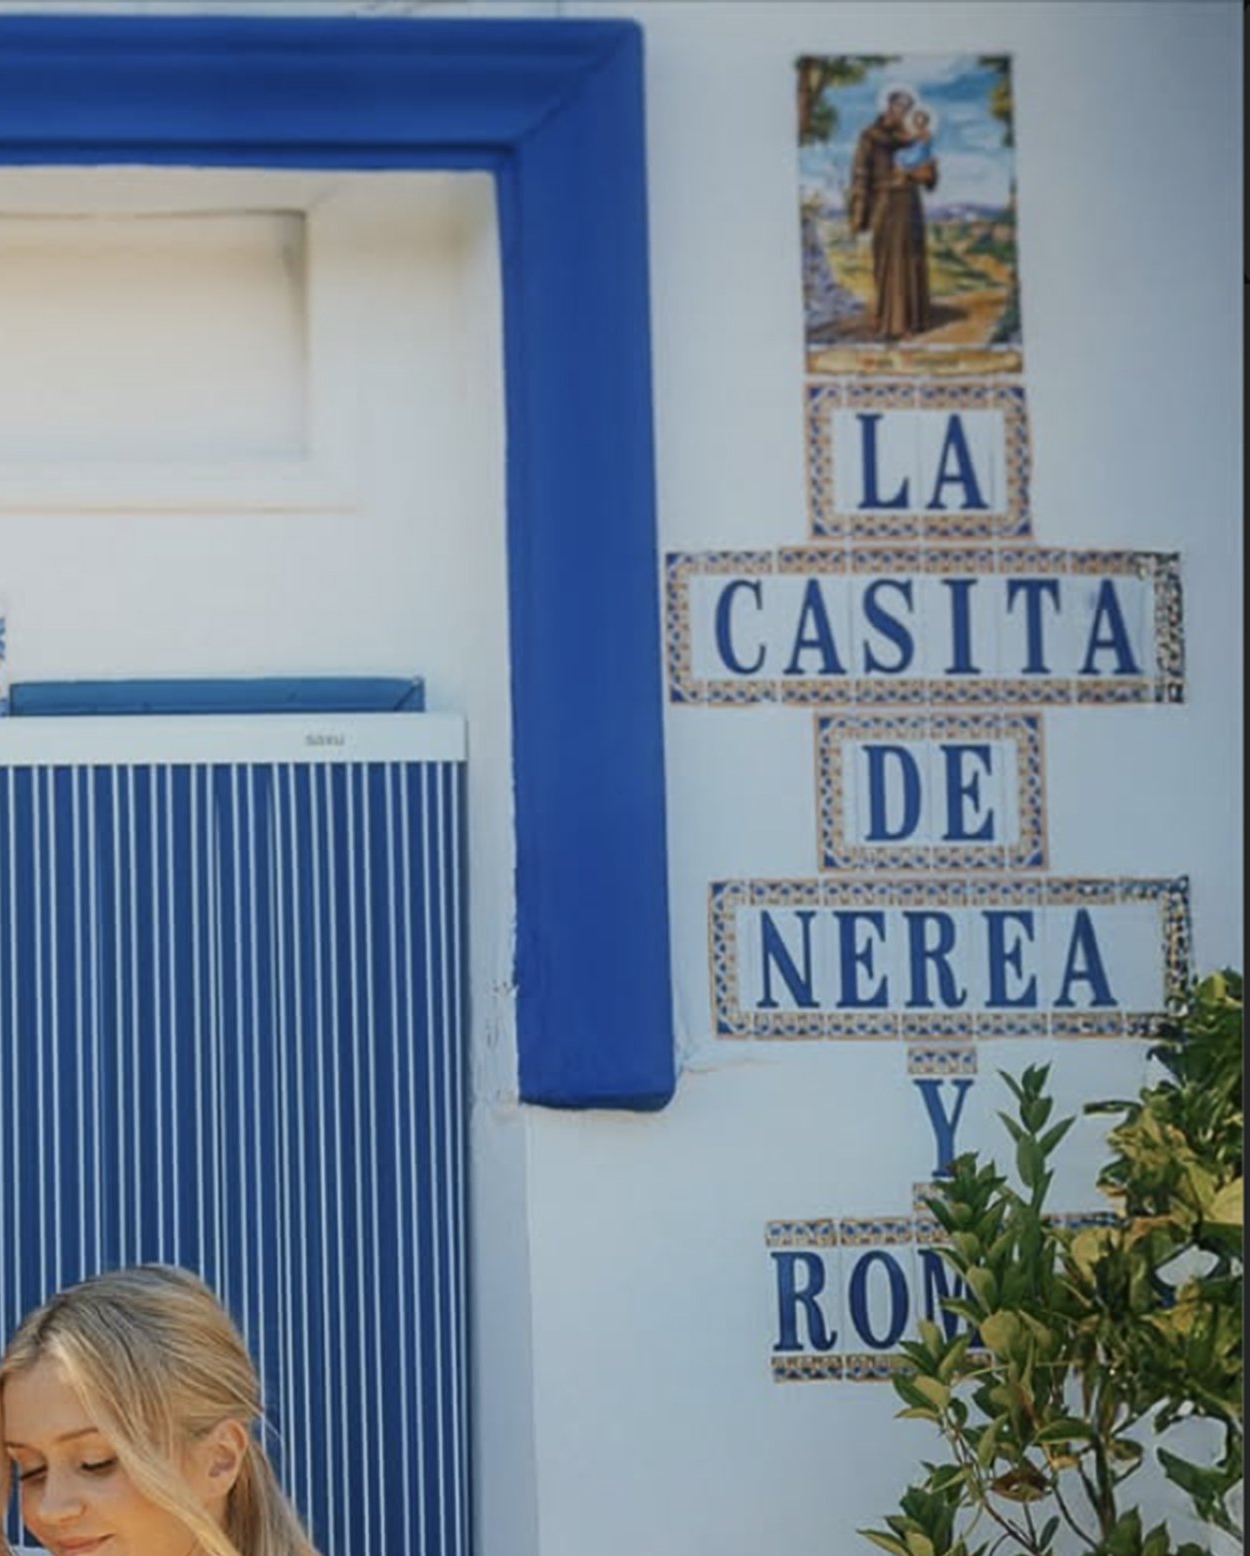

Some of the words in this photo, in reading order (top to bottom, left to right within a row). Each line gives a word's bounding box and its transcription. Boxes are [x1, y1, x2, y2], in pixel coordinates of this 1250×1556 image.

[857, 413, 989, 510] LA
[714, 578, 1143, 676] CASITA
[862, 744, 995, 842] DE
[756, 908, 1119, 1009] NEREA
[913, 1078, 975, 1179] Y
[770, 1250, 986, 1352] ROM
